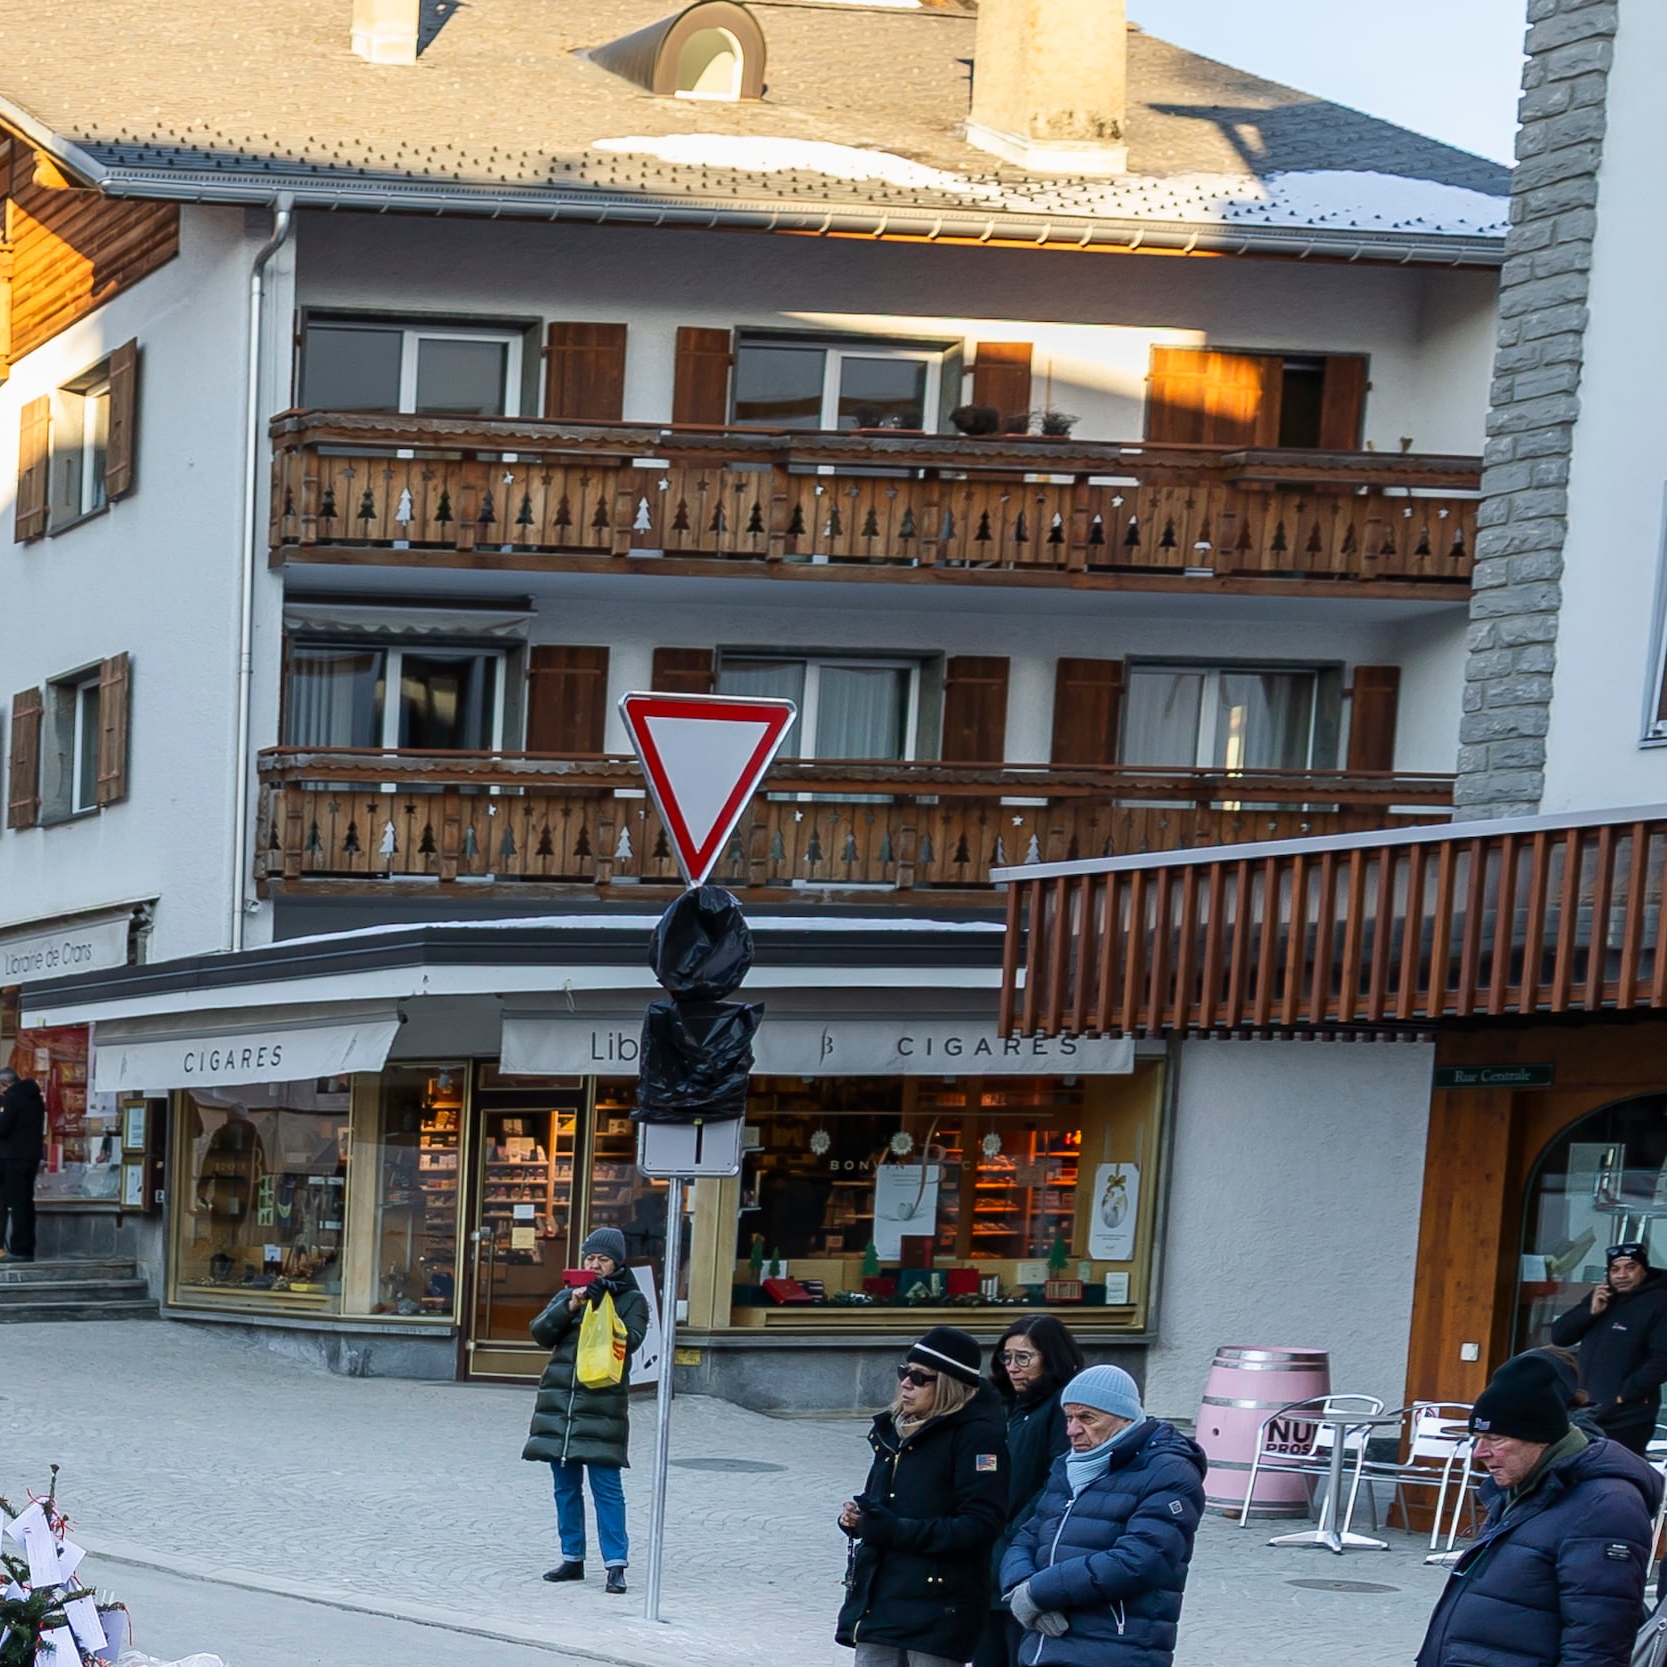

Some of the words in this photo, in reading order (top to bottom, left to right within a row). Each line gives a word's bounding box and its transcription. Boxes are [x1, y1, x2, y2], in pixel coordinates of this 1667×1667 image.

[46, 946, 60, 968] de
[63, 942, 92, 965] Crans
[897, 1037, 1077, 1056] CIGARES
[184, 1045, 283, 1073] CIGARES
[1453, 1070, 1478, 1083] Rue
[1481, 1068, 1532, 1082] Centrale
